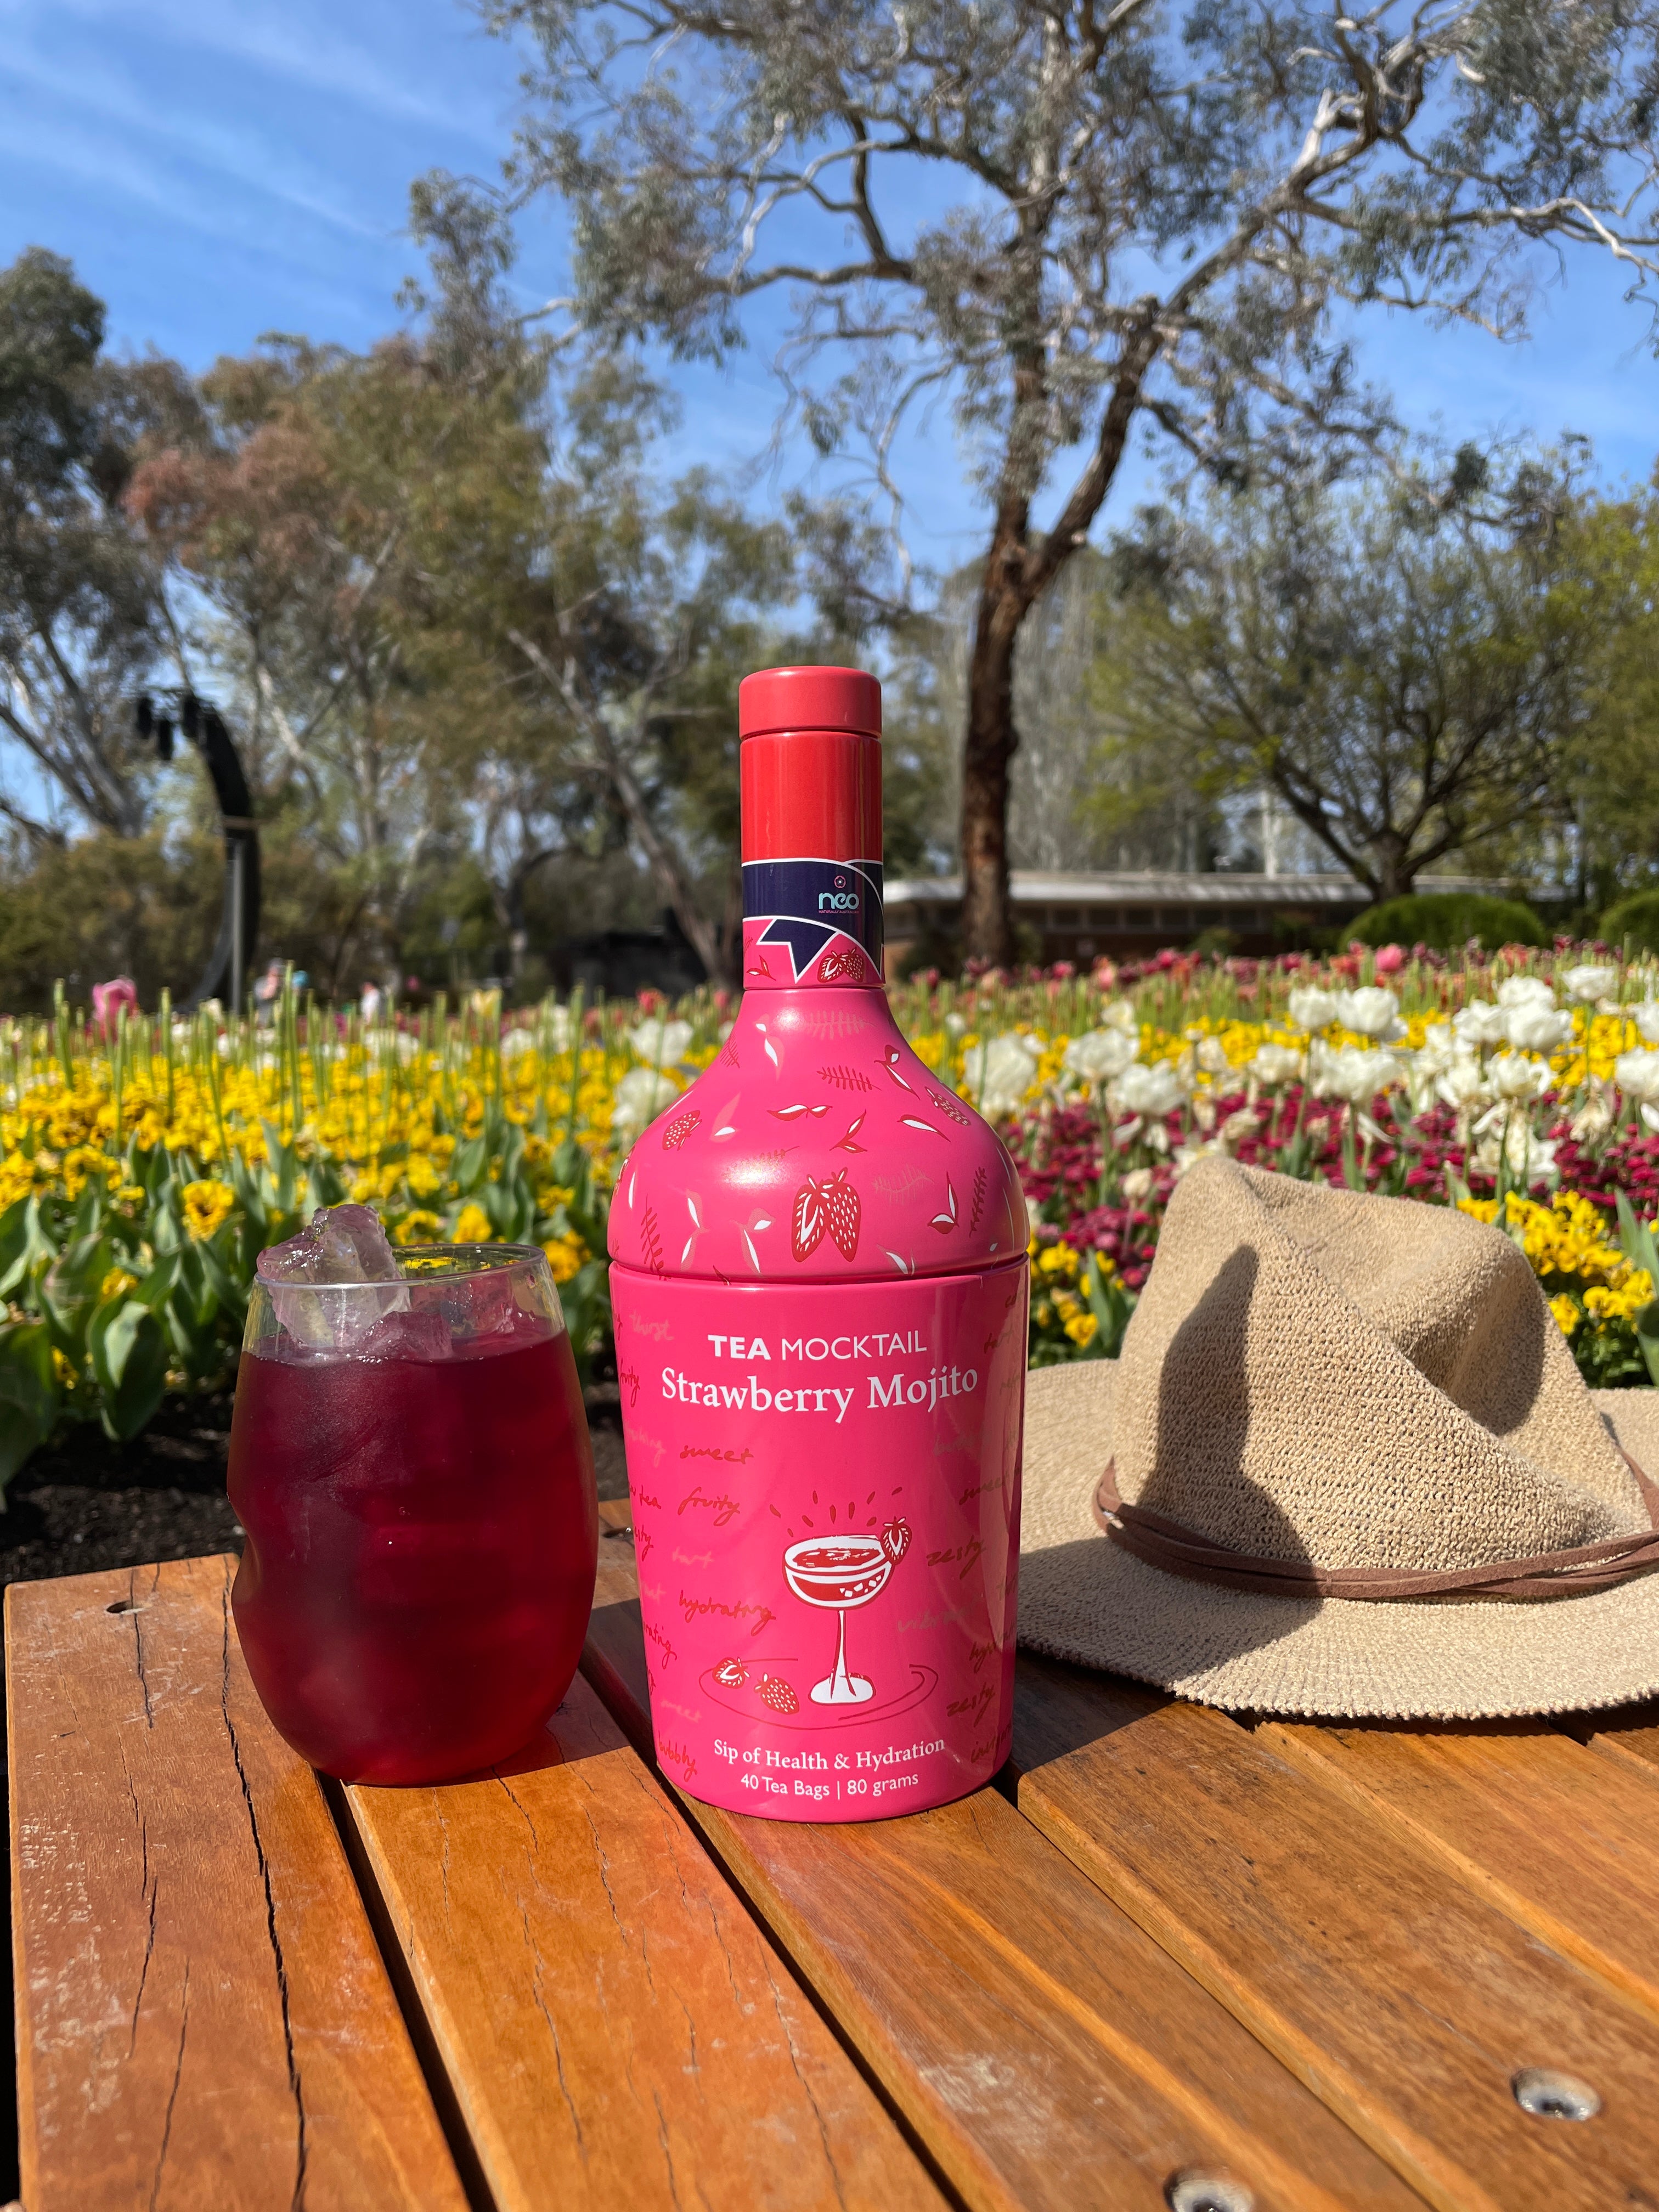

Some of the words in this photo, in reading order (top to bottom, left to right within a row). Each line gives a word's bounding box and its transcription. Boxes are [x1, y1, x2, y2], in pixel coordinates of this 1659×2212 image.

[819, 893, 860, 910] neo
[708, 1334, 771, 1360] TEA
[781, 1330, 927, 1361] MOCKTAIL
[661, 1366, 854, 1424] Strawberry
[867, 1365, 979, 1413] Mojito
[679, 1444, 755, 1465] sweet
[677, 1486, 741, 1527] fruity
[926, 1534, 986, 1580] zesty
[946, 1680, 996, 1728] zesty
[658, 1729, 698, 1783] bubbly
[714, 1739, 738, 1765] Sip
[742, 1747, 762, 1765] of
[765, 1749, 829, 1770] Health
[834, 1753, 851, 1770] &
[855, 1739, 946, 1772] Hydration
[741, 1773, 759, 1790] 40
[761, 1776, 788, 1795] Tea
[794, 1780, 830, 1801] Bags
[847, 1779, 867, 1795] 80
[872, 1774, 920, 1797] grams
